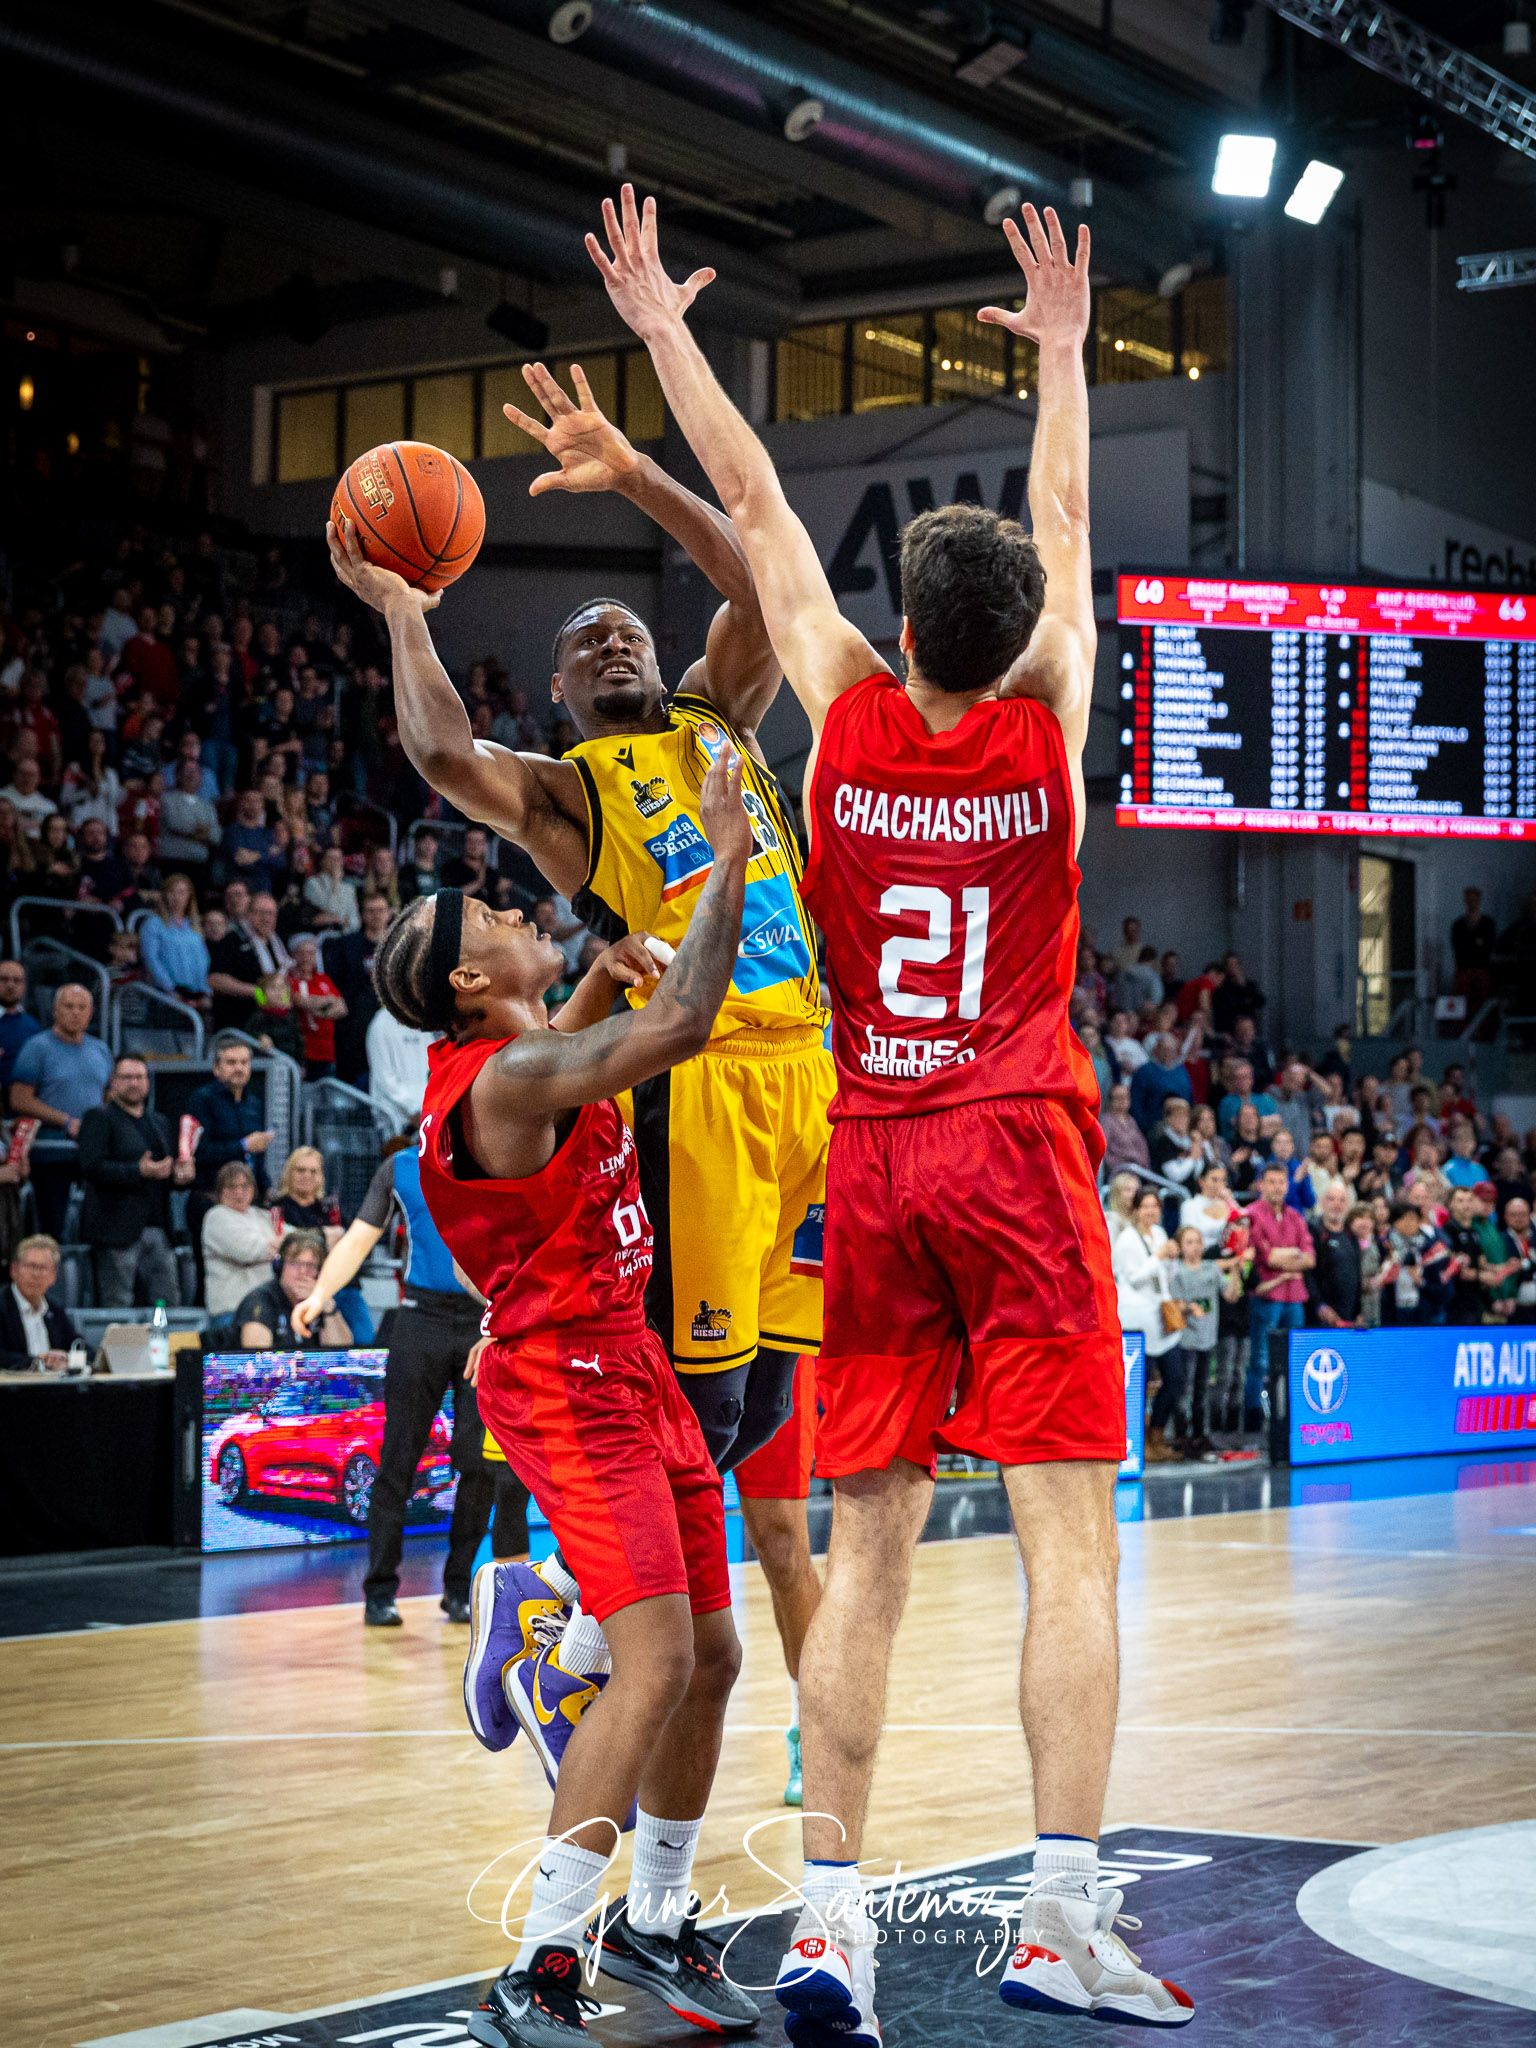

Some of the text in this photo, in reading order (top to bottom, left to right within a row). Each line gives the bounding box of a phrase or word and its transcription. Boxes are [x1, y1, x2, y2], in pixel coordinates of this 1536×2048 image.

[1135, 579, 1164, 604] 60
[1499, 598, 1526, 621] 66
[641, 794, 671, 815] RIESEN
[834, 783, 1048, 842] CHACHASHVILI
[690, 847, 712, 865] BW
[878, 884, 989, 1020] 21
[693, 1329, 725, 1337] RIESEN
[1454, 1342, 1495, 1387] ATB
